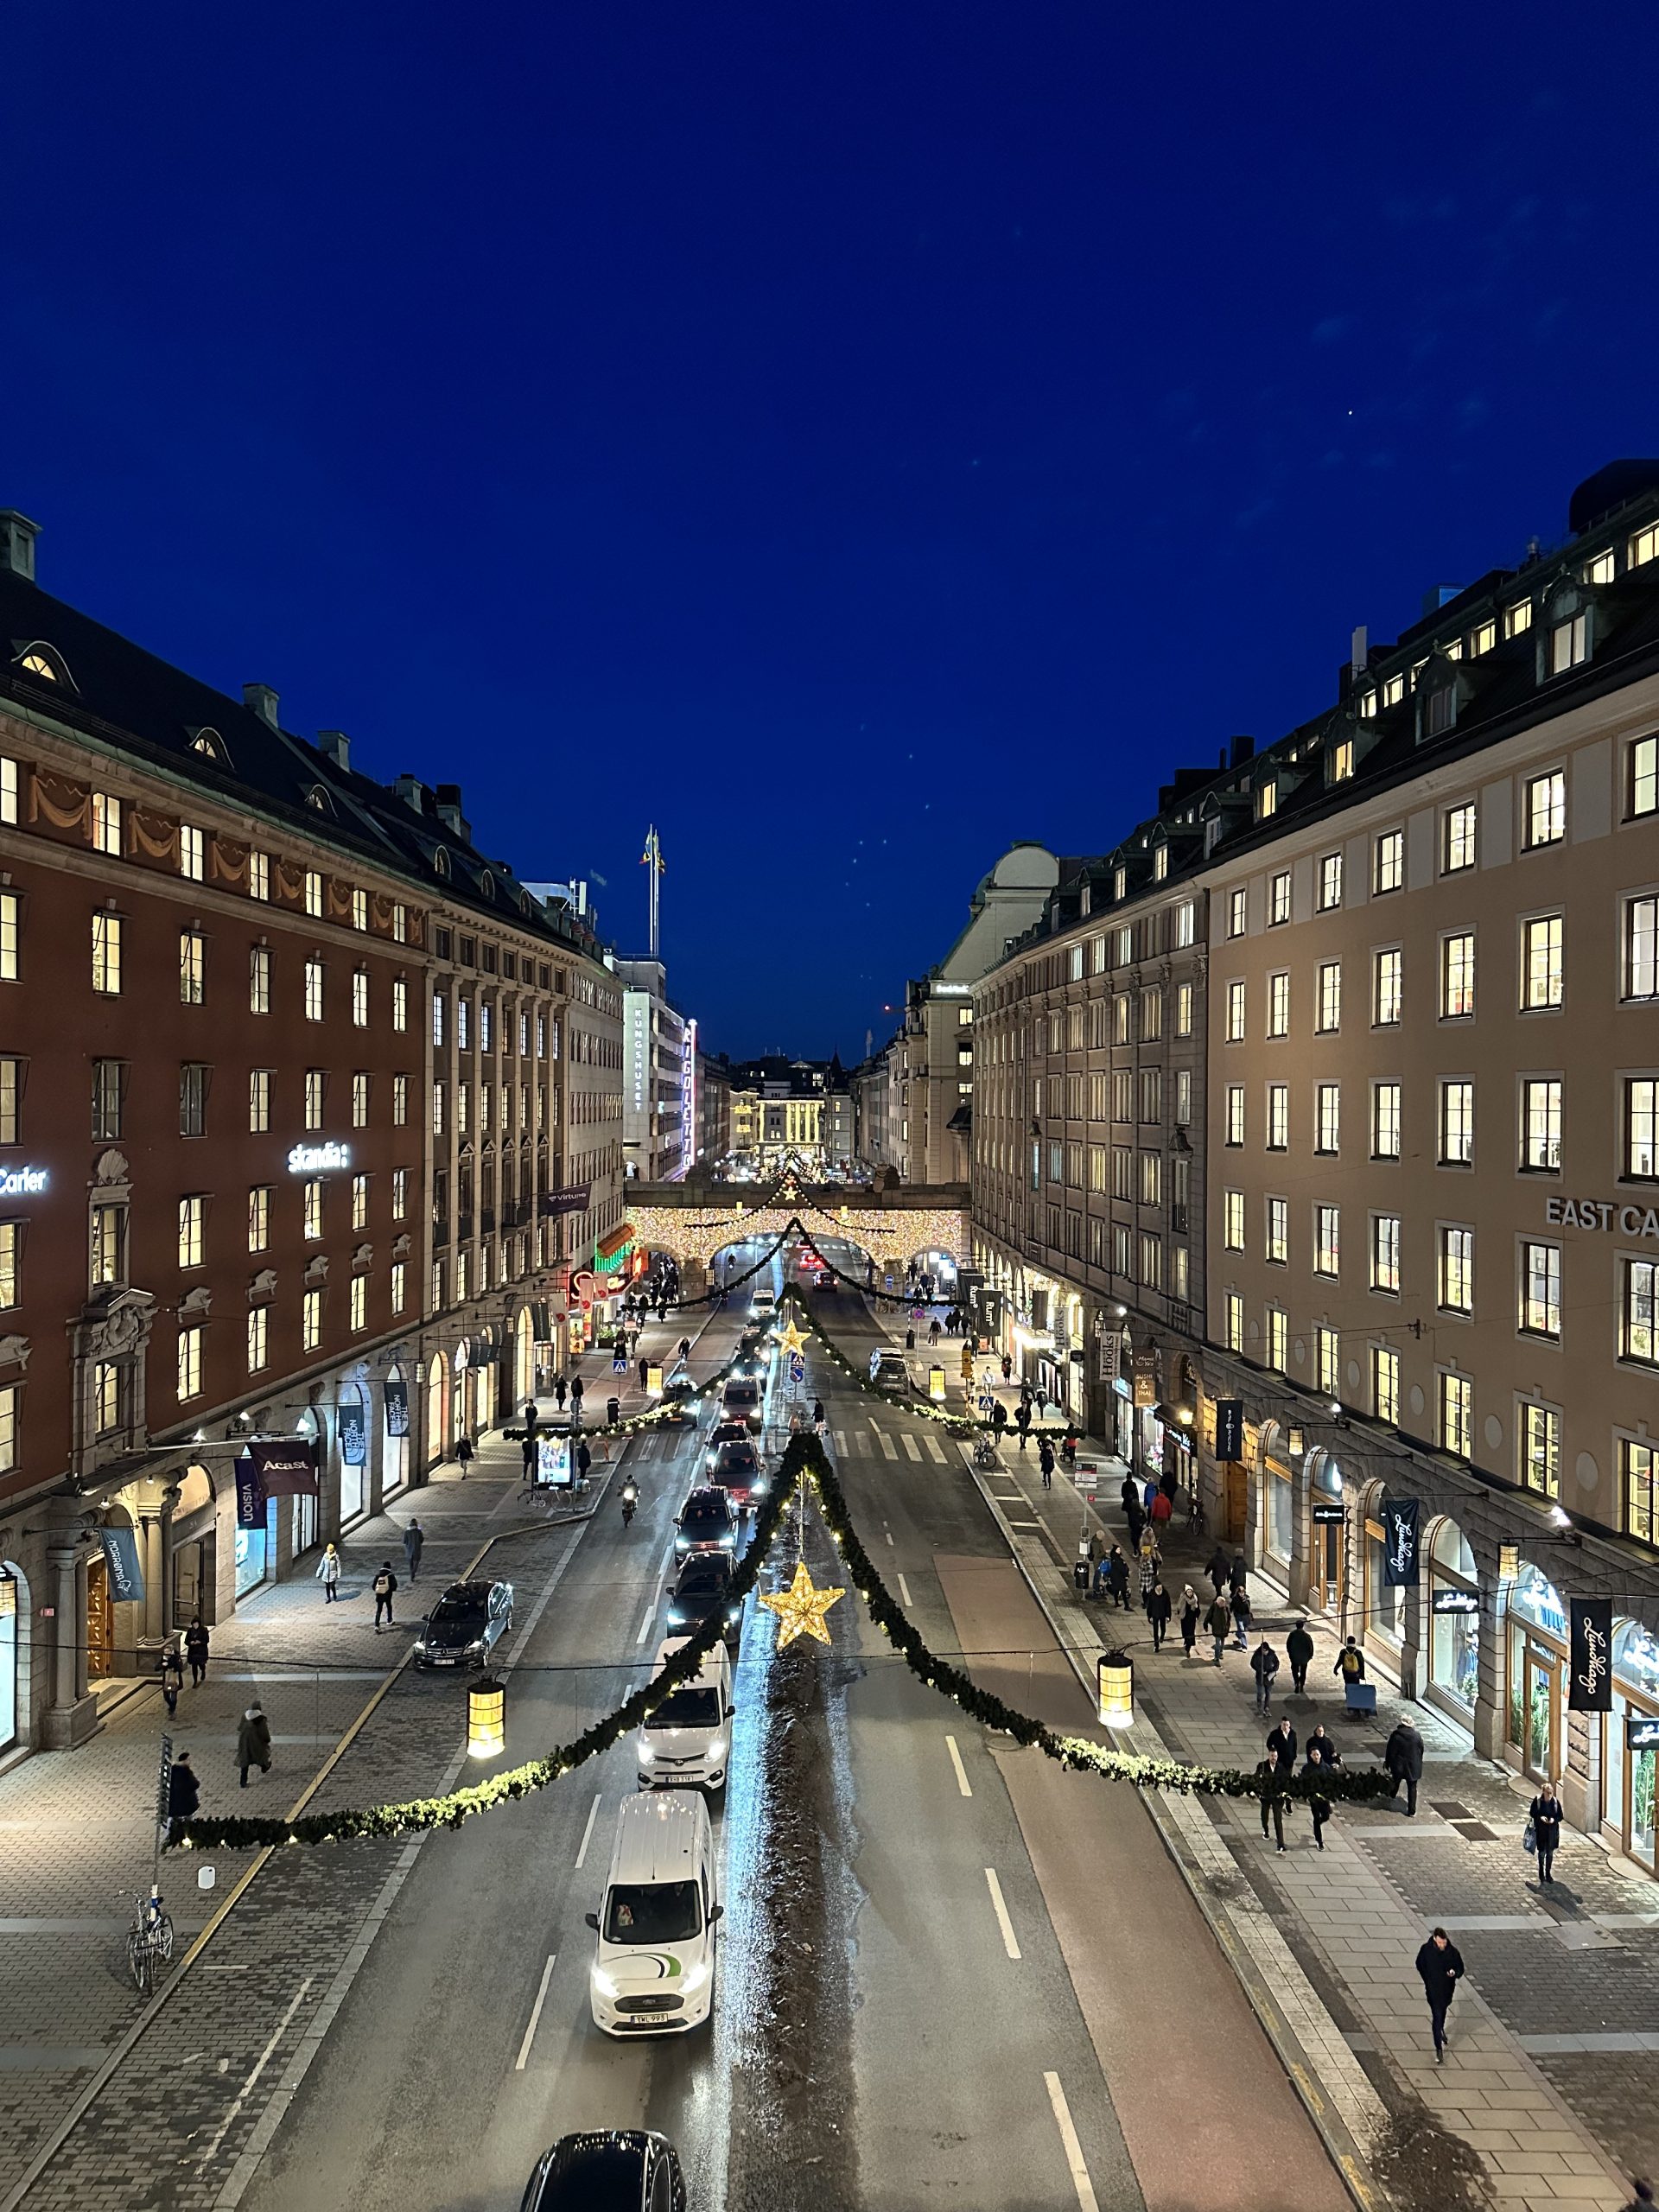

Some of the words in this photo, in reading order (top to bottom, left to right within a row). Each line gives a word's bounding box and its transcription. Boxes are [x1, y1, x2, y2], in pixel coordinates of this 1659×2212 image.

[634, 1008, 643, 1111] KUNGSHUSET
[683, 1027, 692, 1168] RIGOLETTO
[1546, 1197, 1614, 1232] EAST
[1619, 1205, 1659, 1239] CA
[1141, 1380, 1148, 1389] &
[393, 1394, 402, 1422] NORTH
[343, 1427, 352, 1449] FACE
[349, 1419, 359, 1449] NORTH
[356, 1431, 365, 1449] THE
[262, 1459, 309, 1471] Acast
[108, 1540, 125, 1582] NORRØNA
[1389, 1513, 1413, 1573] Lundhags
[1578, 1617, 1607, 1694] Lundhags
